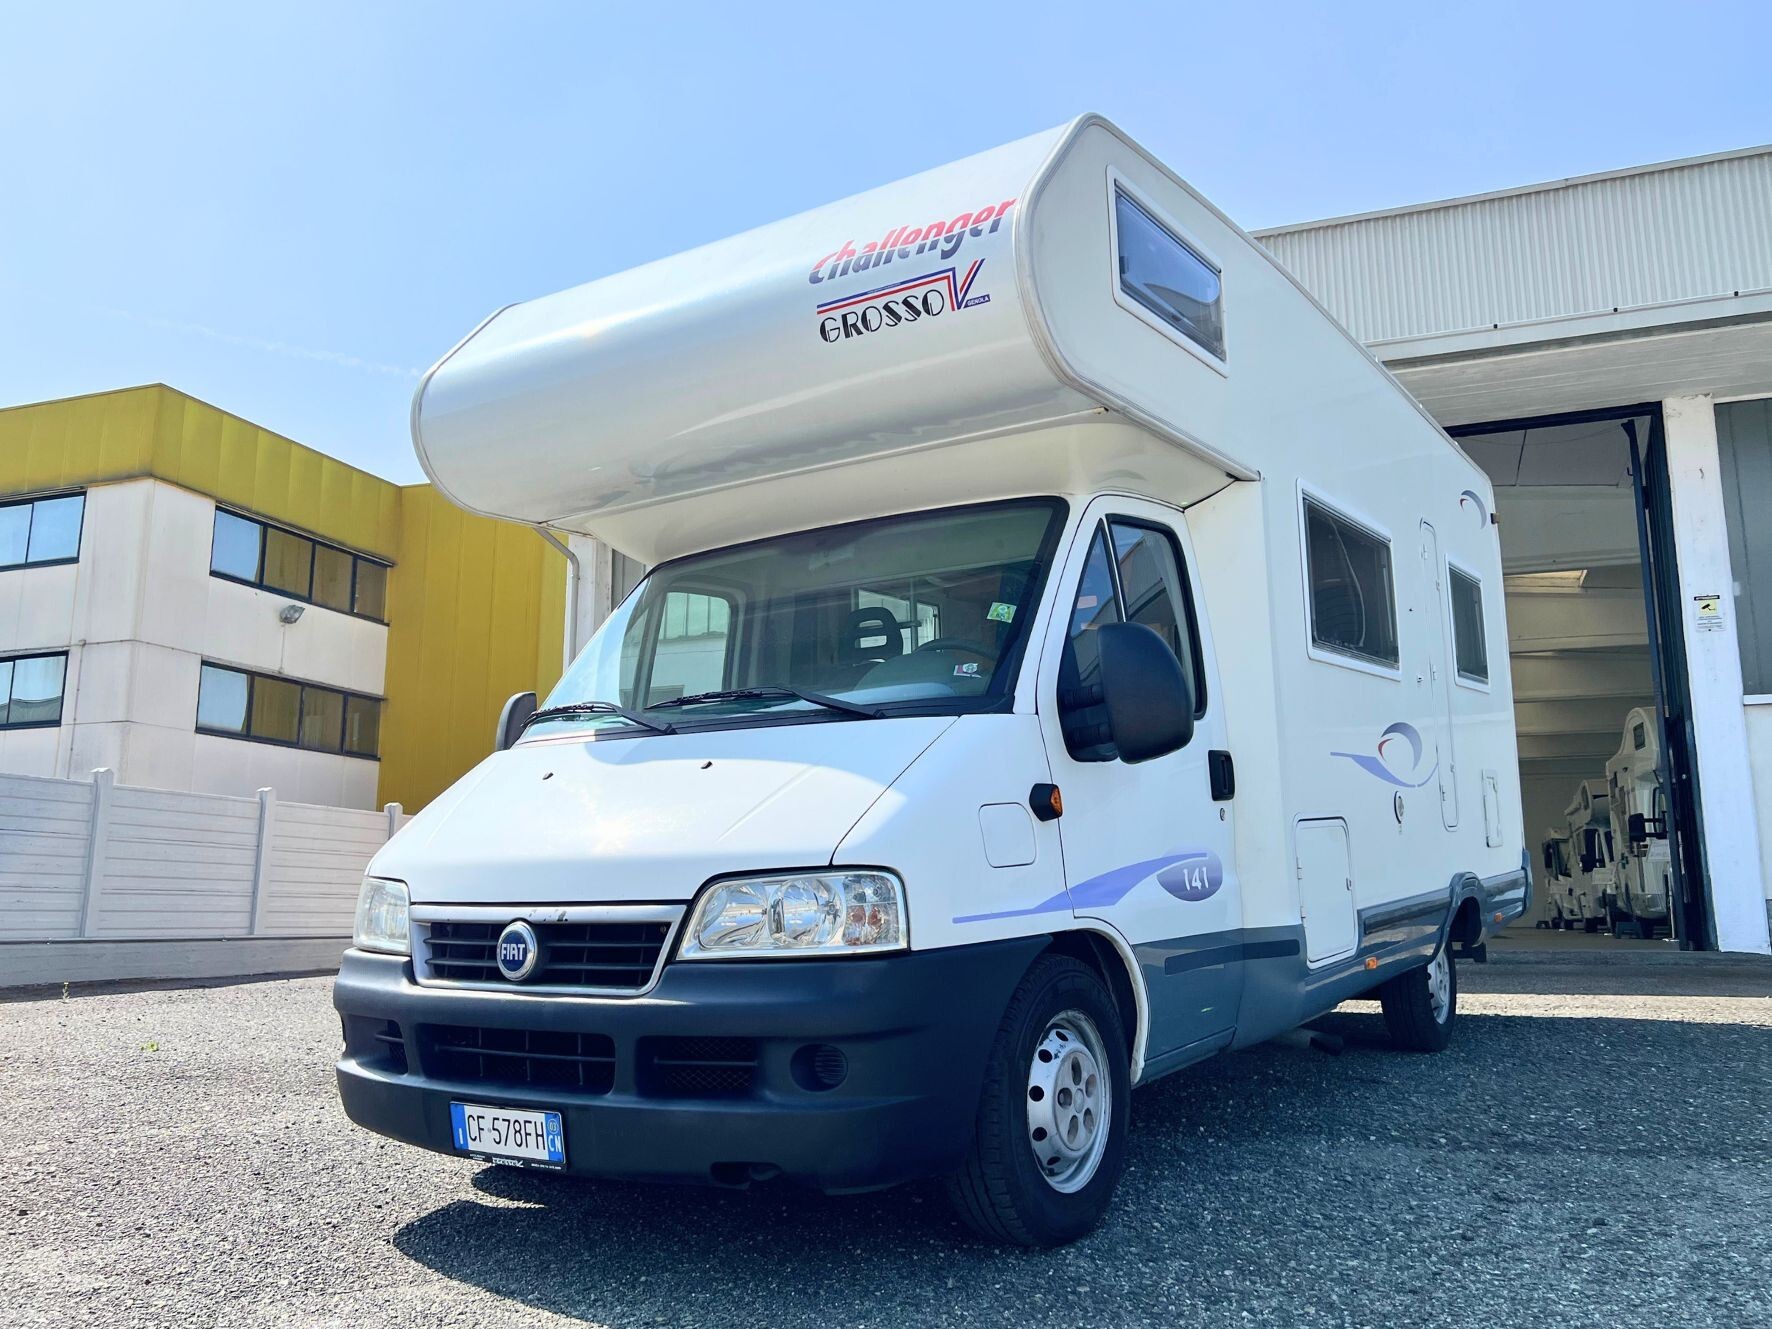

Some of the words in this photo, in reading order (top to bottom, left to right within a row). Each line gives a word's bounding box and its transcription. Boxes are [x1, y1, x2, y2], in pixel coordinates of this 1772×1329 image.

[808, 199, 1017, 285] Challenger
[819, 289, 945, 343] GROSSO
[1183, 866, 1209, 891] 141
[501, 943, 526, 961] FIAT
[547, 1134, 562, 1153] CN
